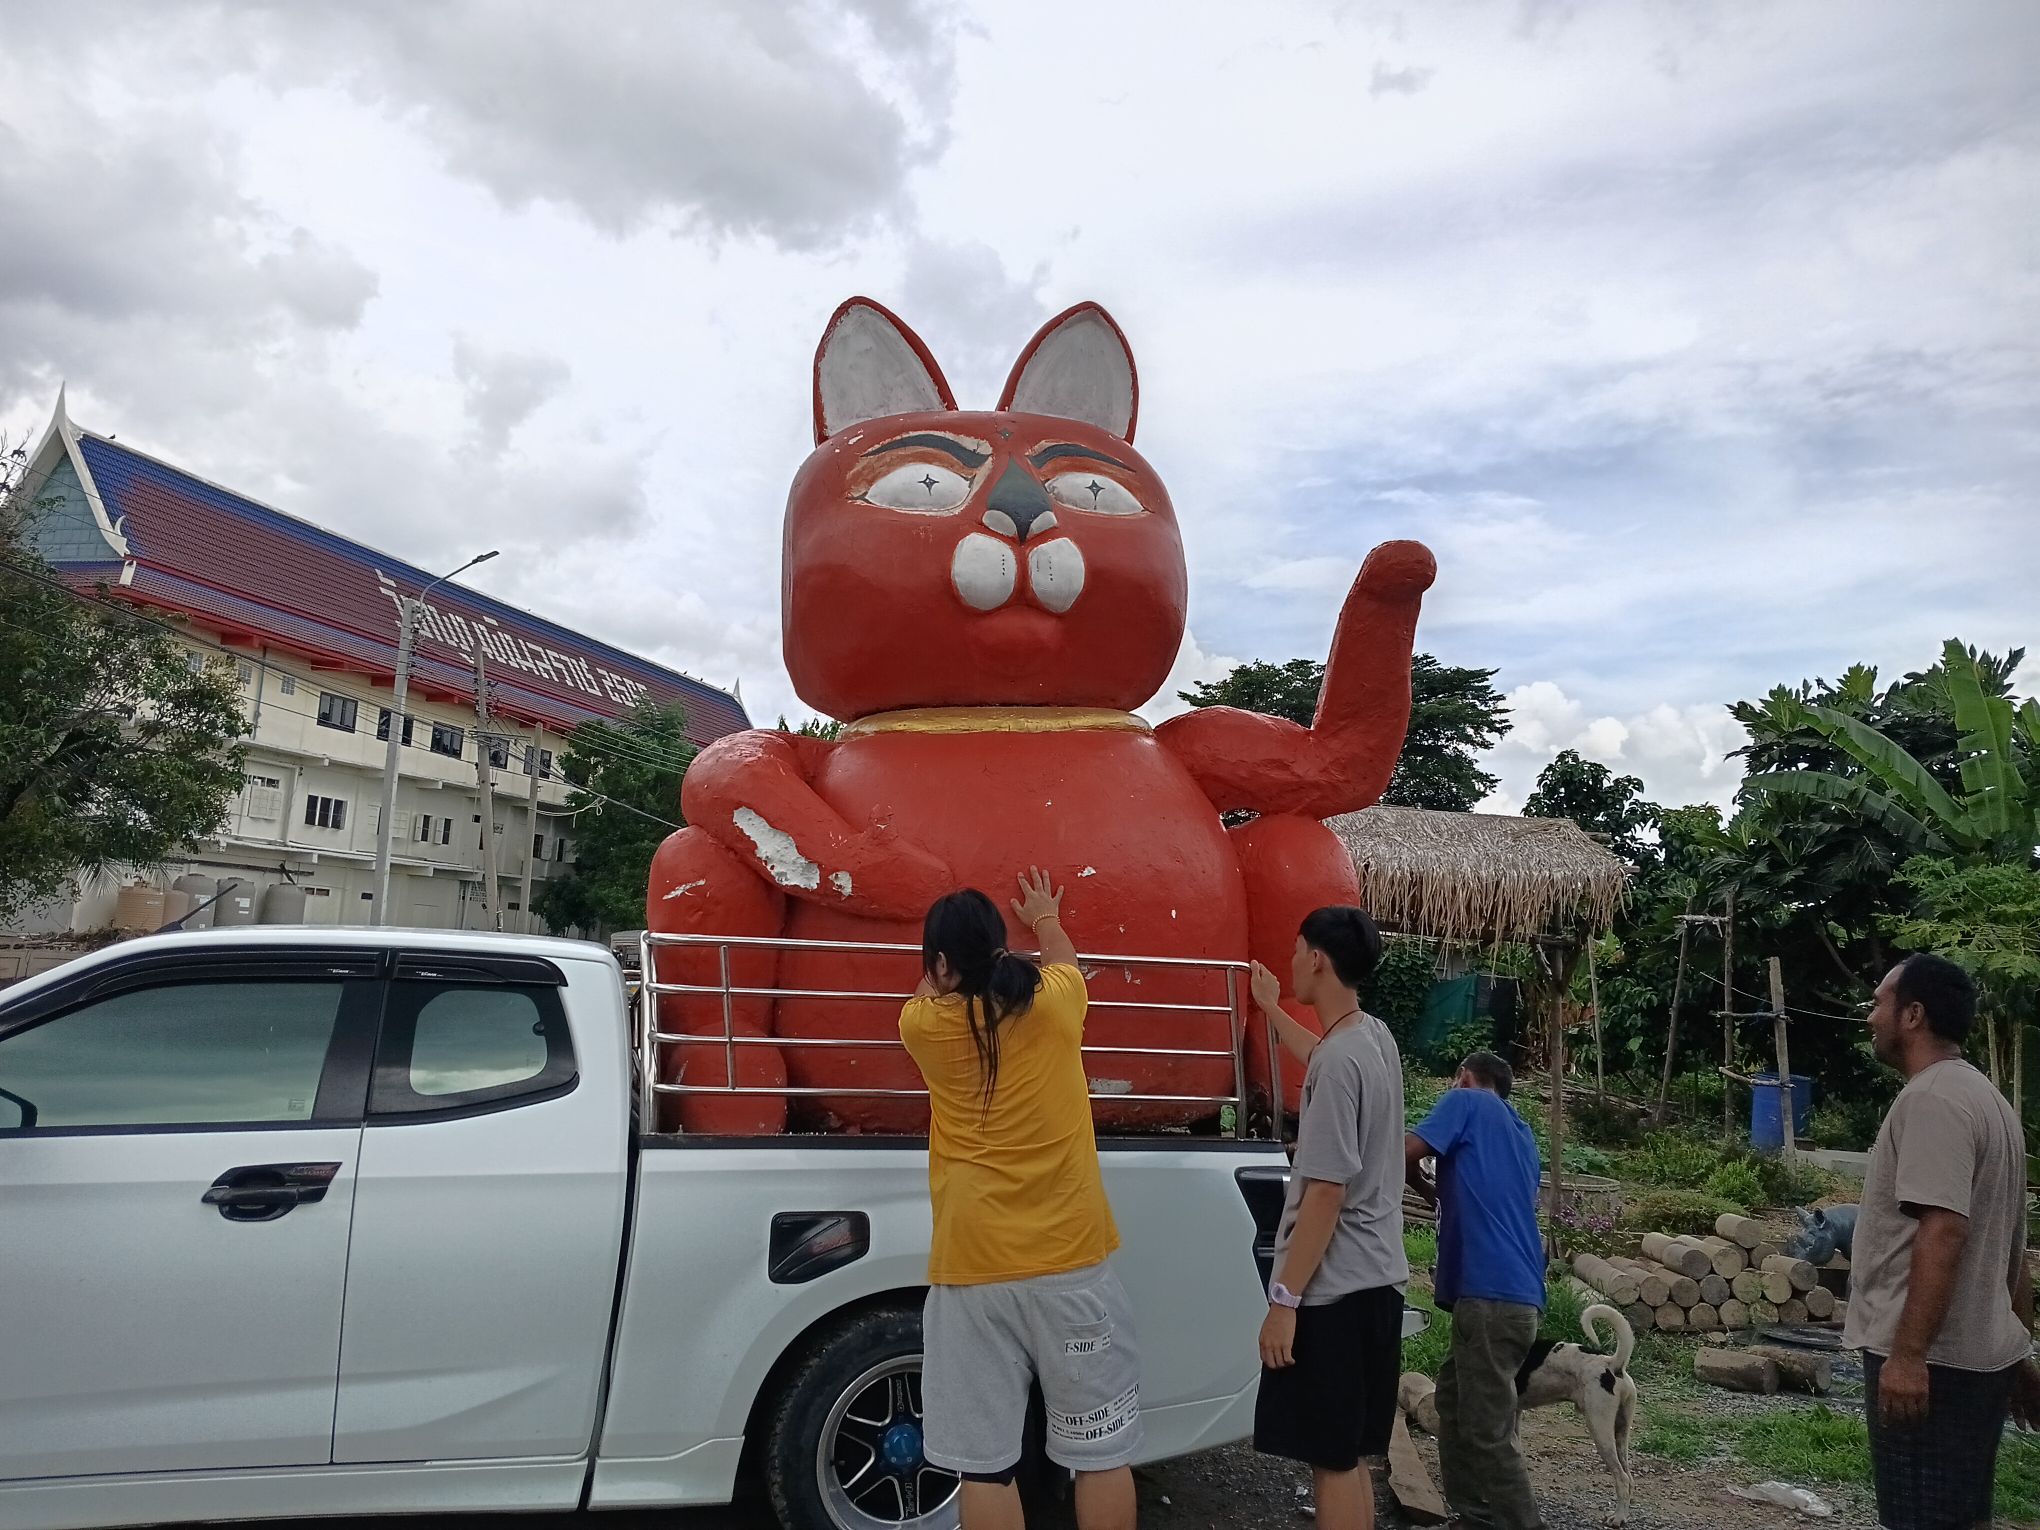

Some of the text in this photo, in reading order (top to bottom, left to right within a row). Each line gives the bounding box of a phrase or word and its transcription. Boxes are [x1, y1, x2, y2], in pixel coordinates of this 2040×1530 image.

[1065, 1340, 1097, 1353] F-SIDE
[1065, 1406, 1110, 1426] OFF-SIDE
[1085, 1415, 1126, 1441] OFF-SIDE
